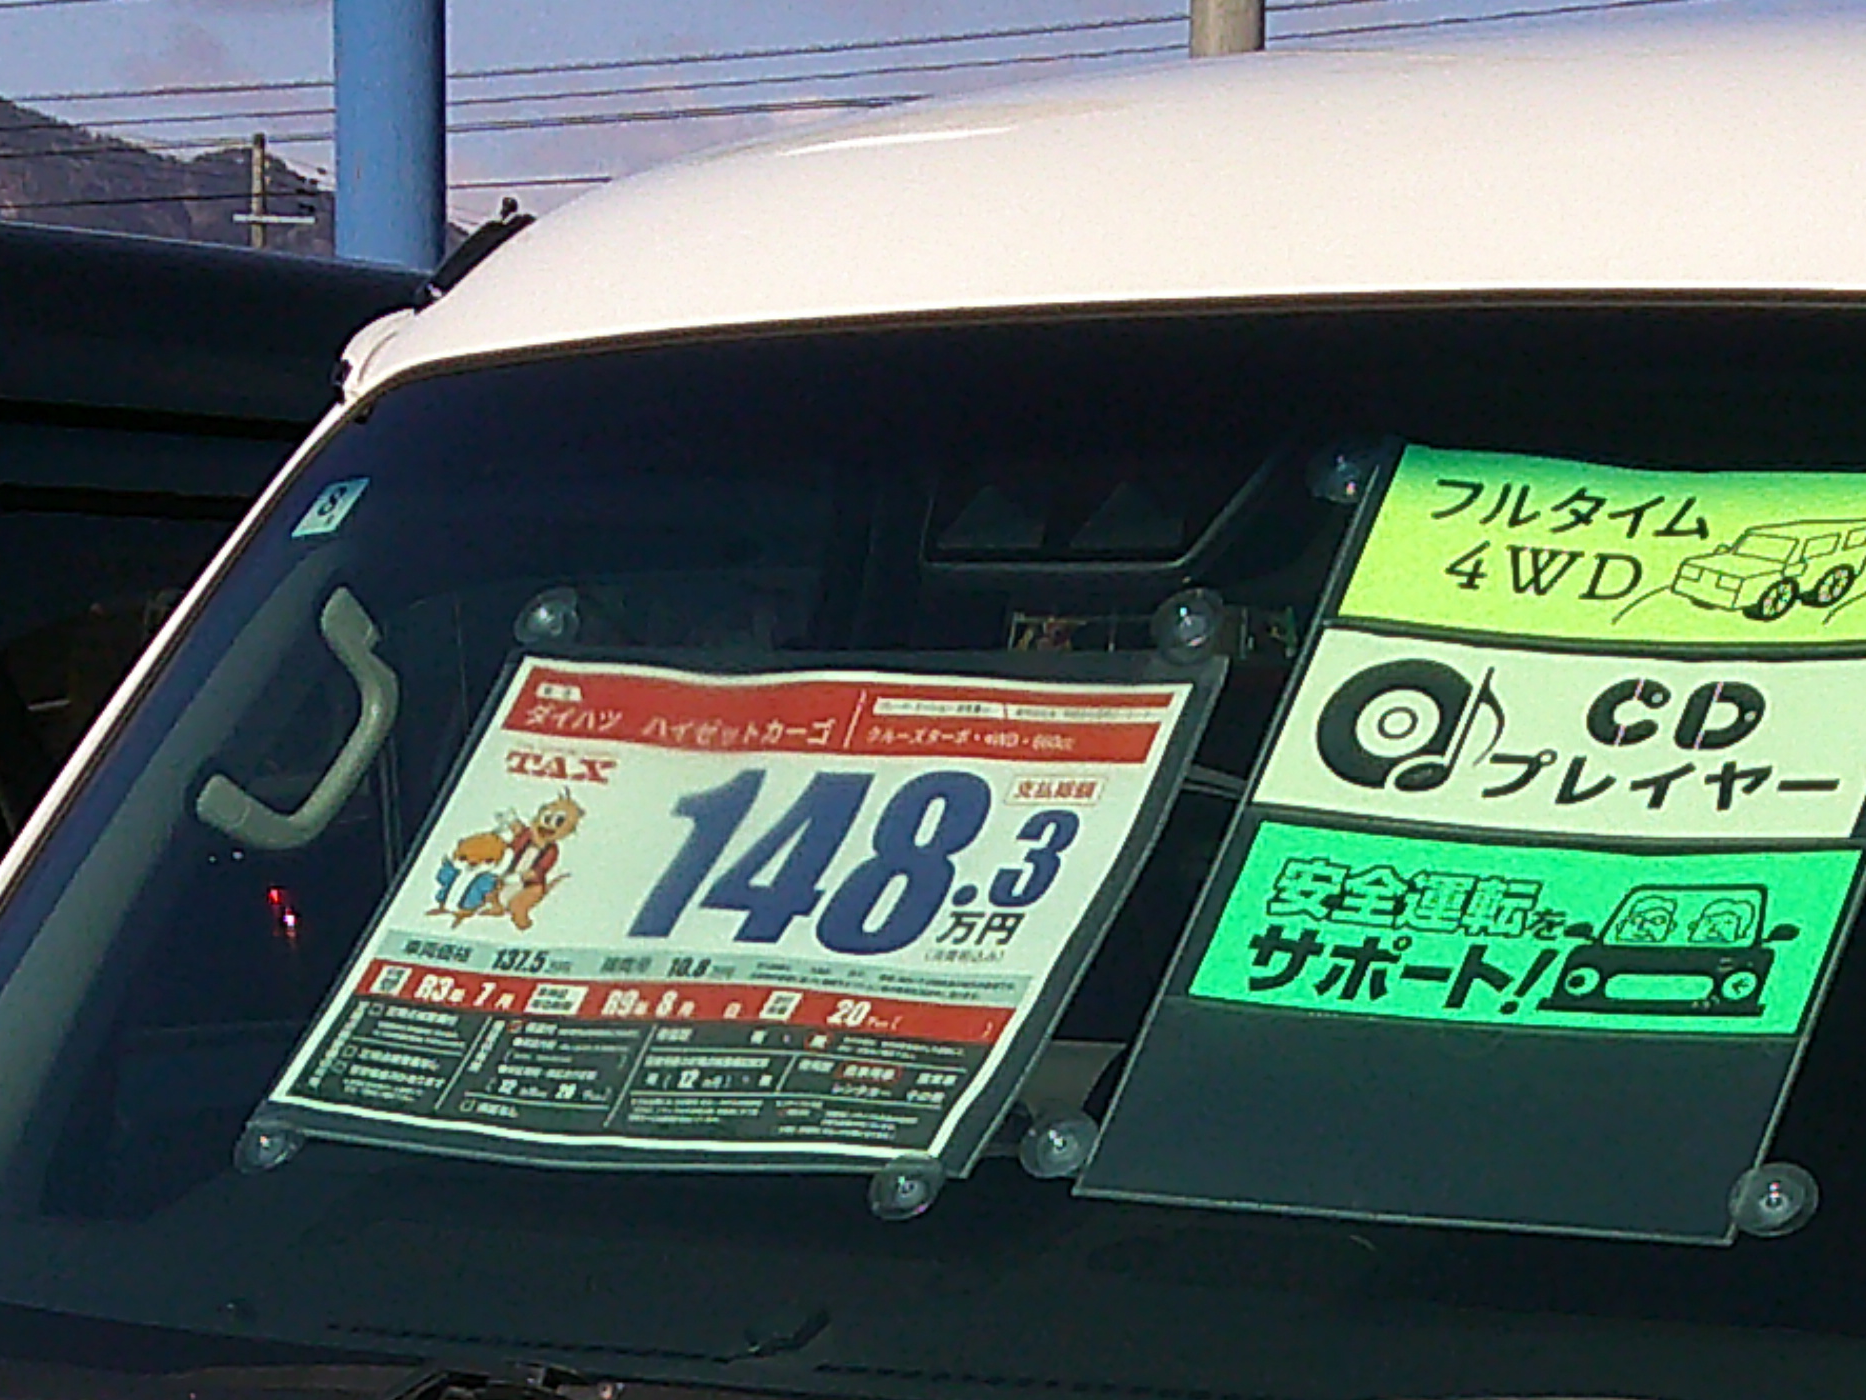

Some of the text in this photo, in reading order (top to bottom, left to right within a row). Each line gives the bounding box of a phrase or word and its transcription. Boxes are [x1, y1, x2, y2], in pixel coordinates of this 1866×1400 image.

[1430, 478, 1710, 541] フルタイム
[1445, 540, 1643, 601] 4WD
[525, 703, 837, 747] ダイハツ ハイゼットカーゴ
[1586, 678, 1767, 750] CD
[505, 749, 618, 785] TAX
[1481, 748, 1841, 812] プレイヤー
[629, 767, 1081, 956] 148.3 万円
[1265, 856, 1567, 941] 安全運転を
[826, 999, 872, 1028] 20
